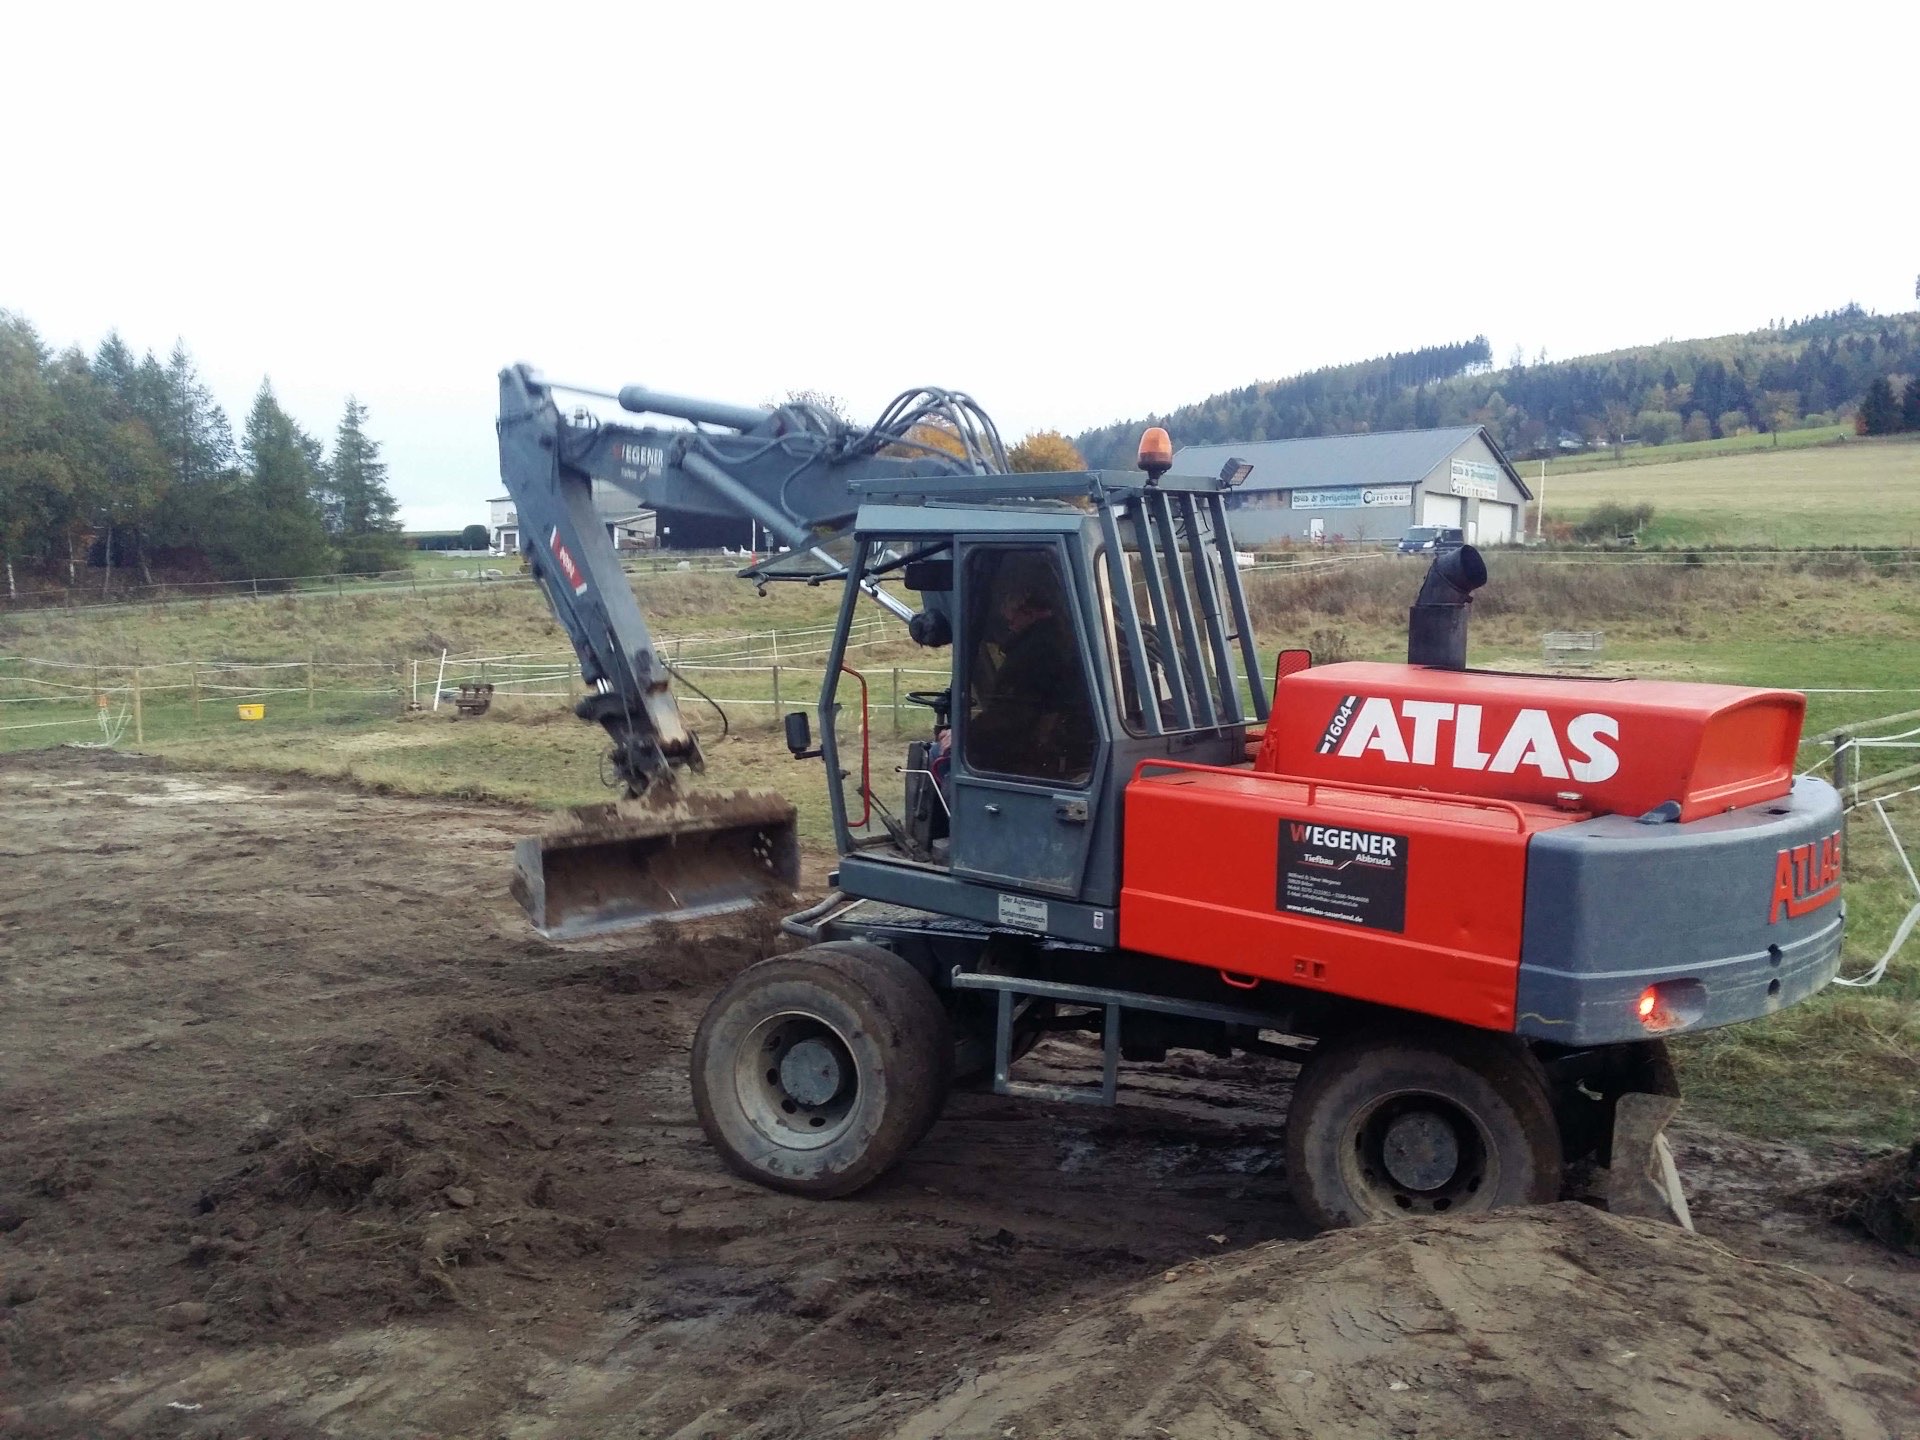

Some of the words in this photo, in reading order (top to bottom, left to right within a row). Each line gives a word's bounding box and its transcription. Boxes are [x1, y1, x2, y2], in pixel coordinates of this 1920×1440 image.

[1324, 705, 1354, 745] 1604
[1338, 697, 1620, 783] ATLAS
[1290, 822, 1397, 857] WEGENER
[1303, 853, 1334, 866] Tiefbau
[1355, 853, 1391, 867] Abbruch
[1769, 830, 1841, 924] ATLAS
[1286, 904, 1363, 922] www.tiefbau-sauerland.de
